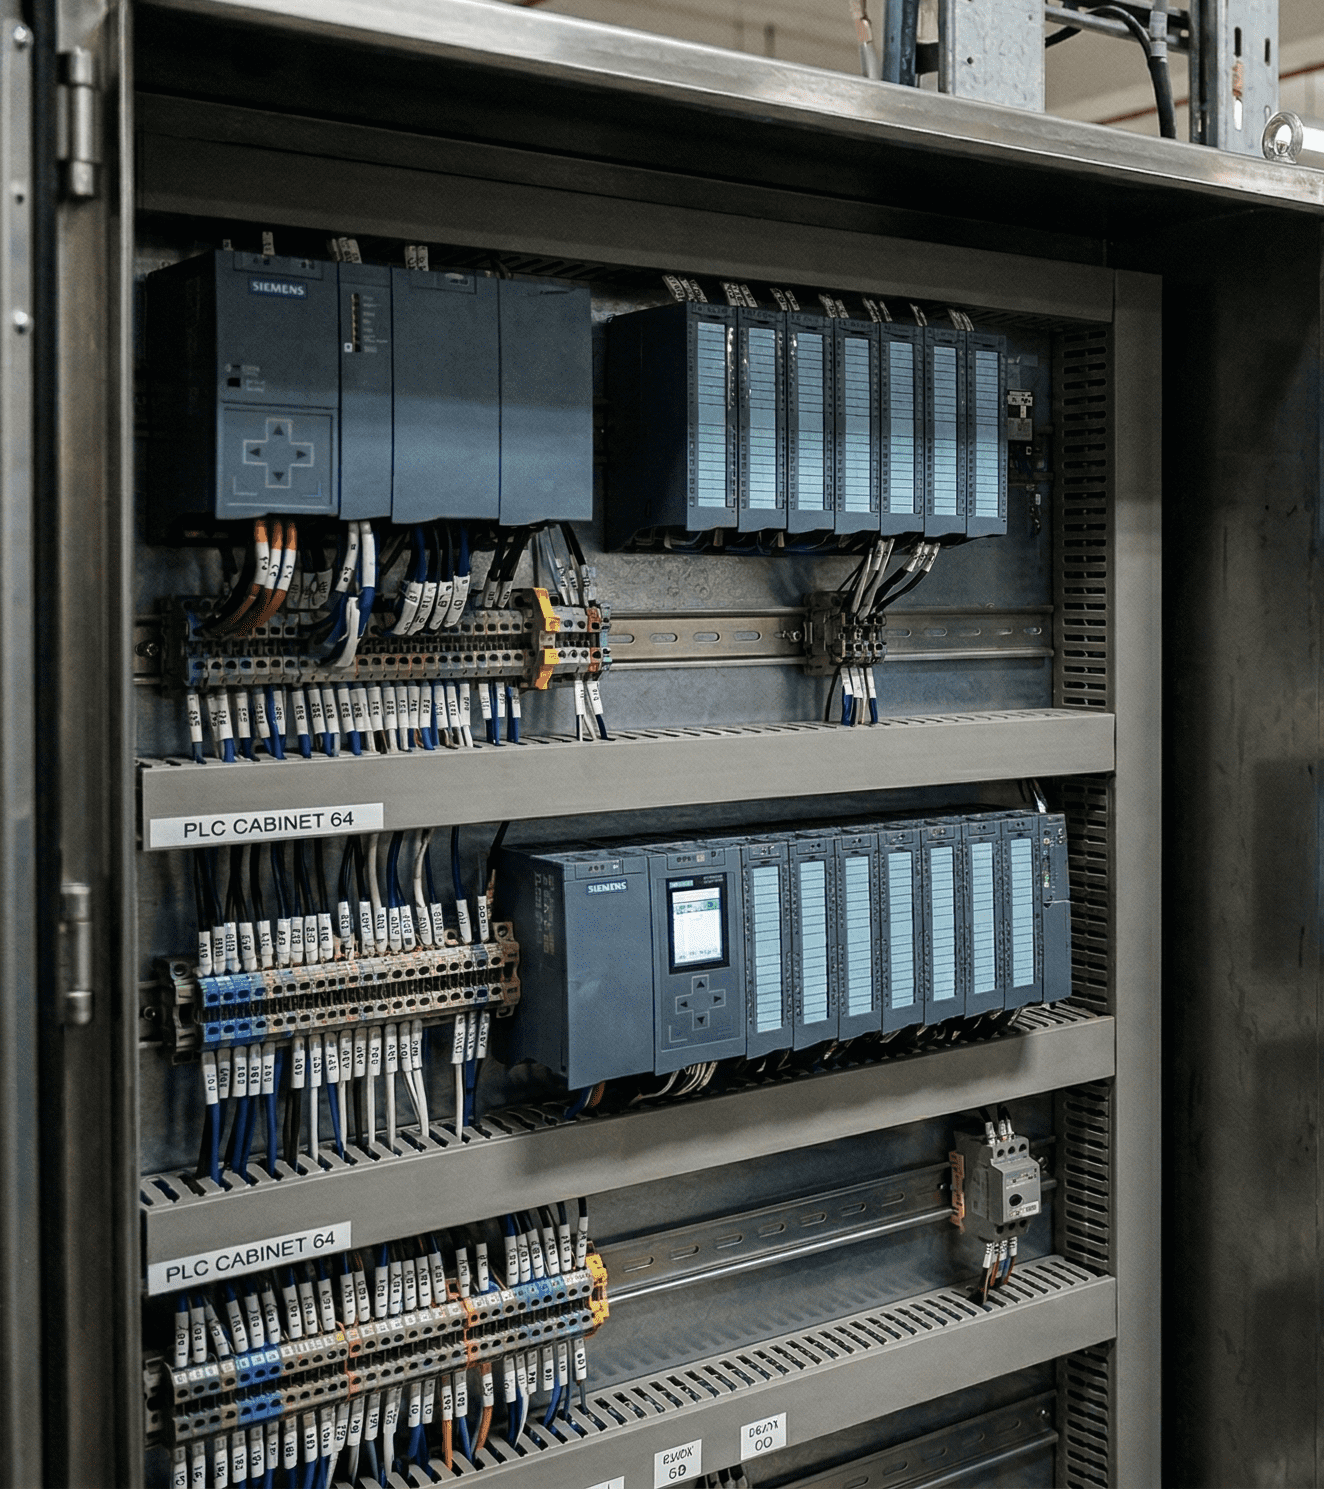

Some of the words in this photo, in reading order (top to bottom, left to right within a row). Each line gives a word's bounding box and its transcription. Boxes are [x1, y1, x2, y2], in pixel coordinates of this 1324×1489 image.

[252, 281, 305, 296] SIEMENS
[183, 820, 227, 839] PLC
[233, 812, 325, 835] CABINET
[330, 811, 355, 828] 64
[165, 1259, 210, 1283] PLC
[215, 1237, 308, 1272] CABINET
[312, 1230, 336, 1249] 64
